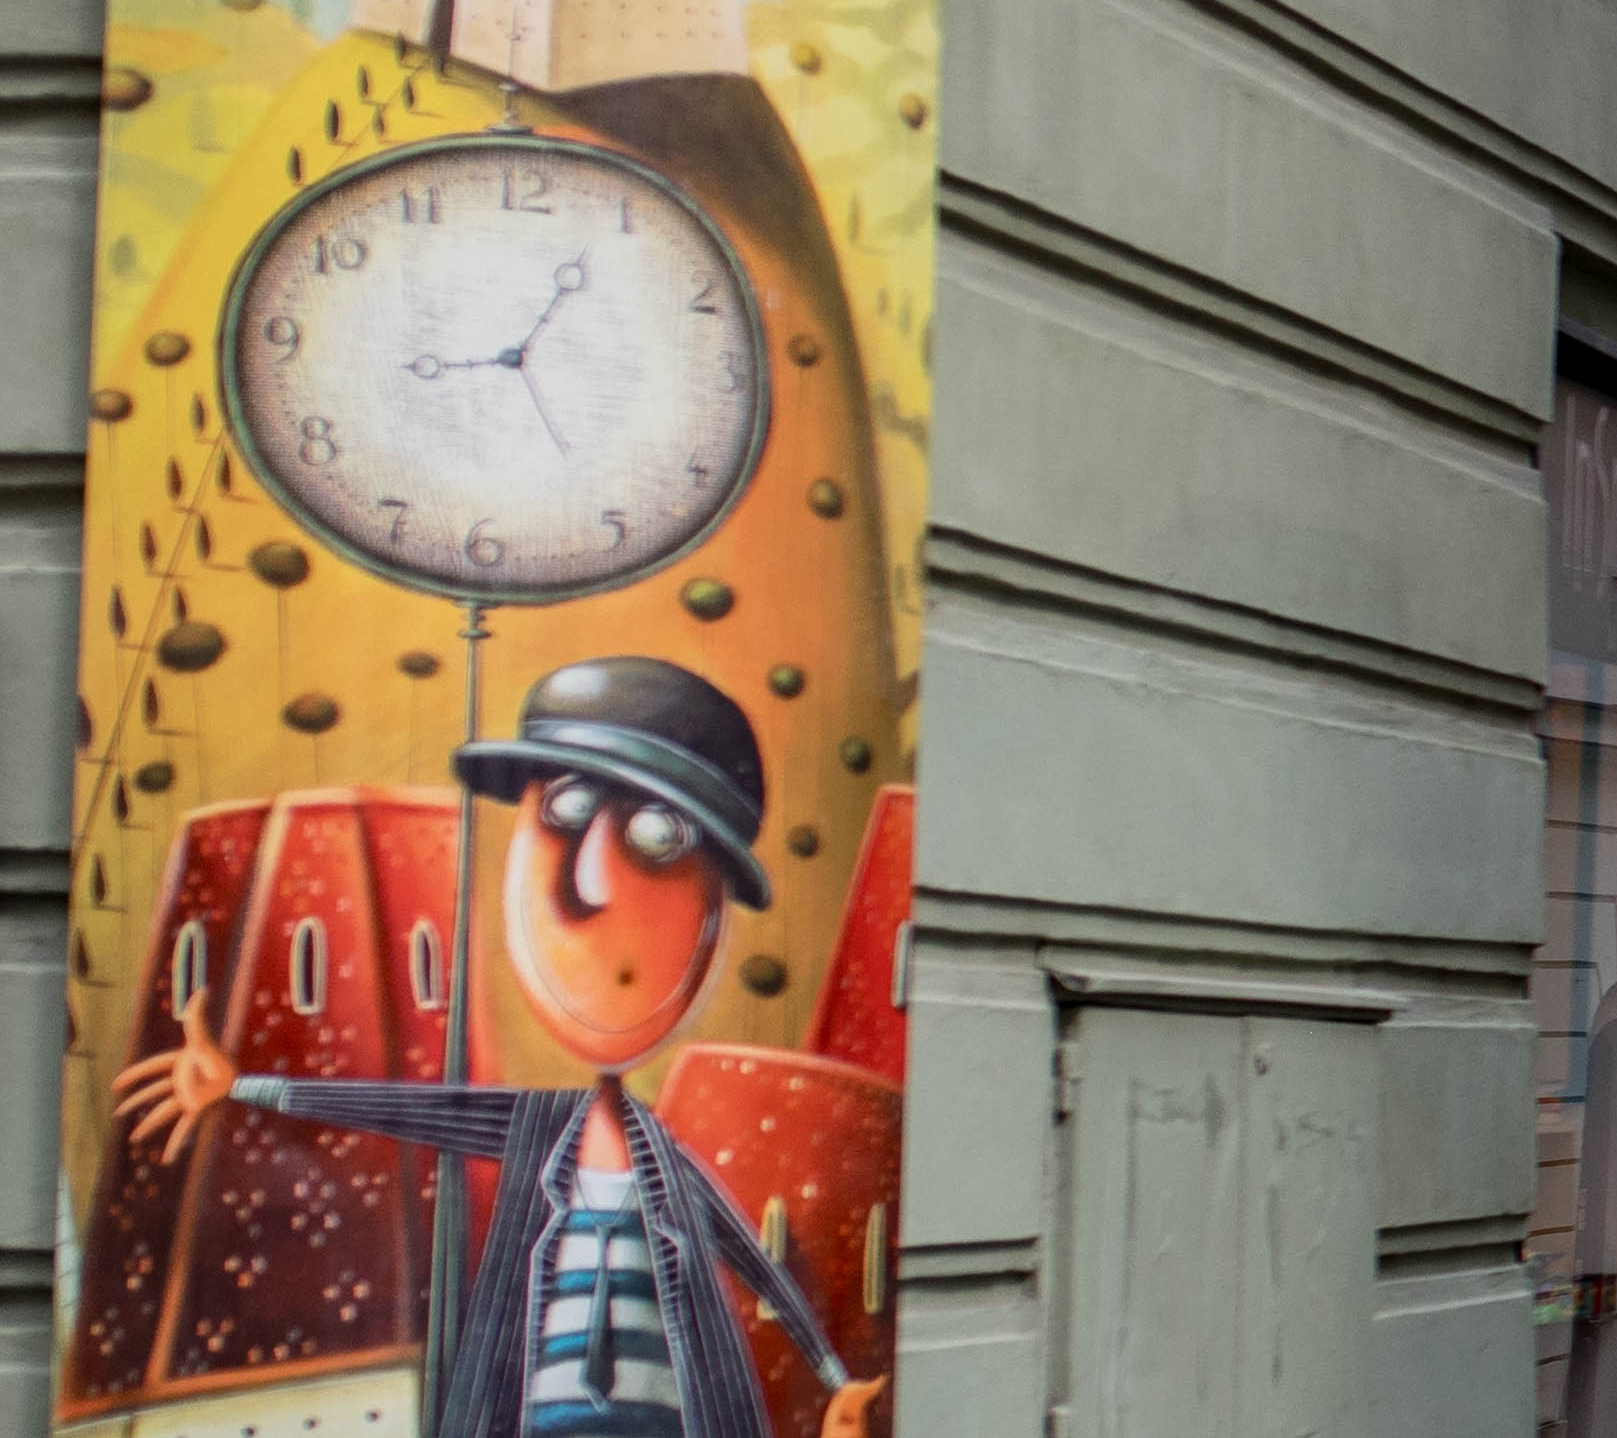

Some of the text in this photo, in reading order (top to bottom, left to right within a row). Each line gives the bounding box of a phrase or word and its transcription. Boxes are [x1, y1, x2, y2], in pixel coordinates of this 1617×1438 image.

[400, 184, 443, 225] 11
[499, 166, 553, 216] 12
[618, 196, 634, 235] 1
[311, 233, 369, 276] 10
[688, 269, 718, 315] 2
[263, 315, 301, 363] 9
[297, 415, 339, 467] 8
[378, 497, 409, 546] 7
[464, 516, 505, 569] 6
[600, 509, 628, 554] 5
